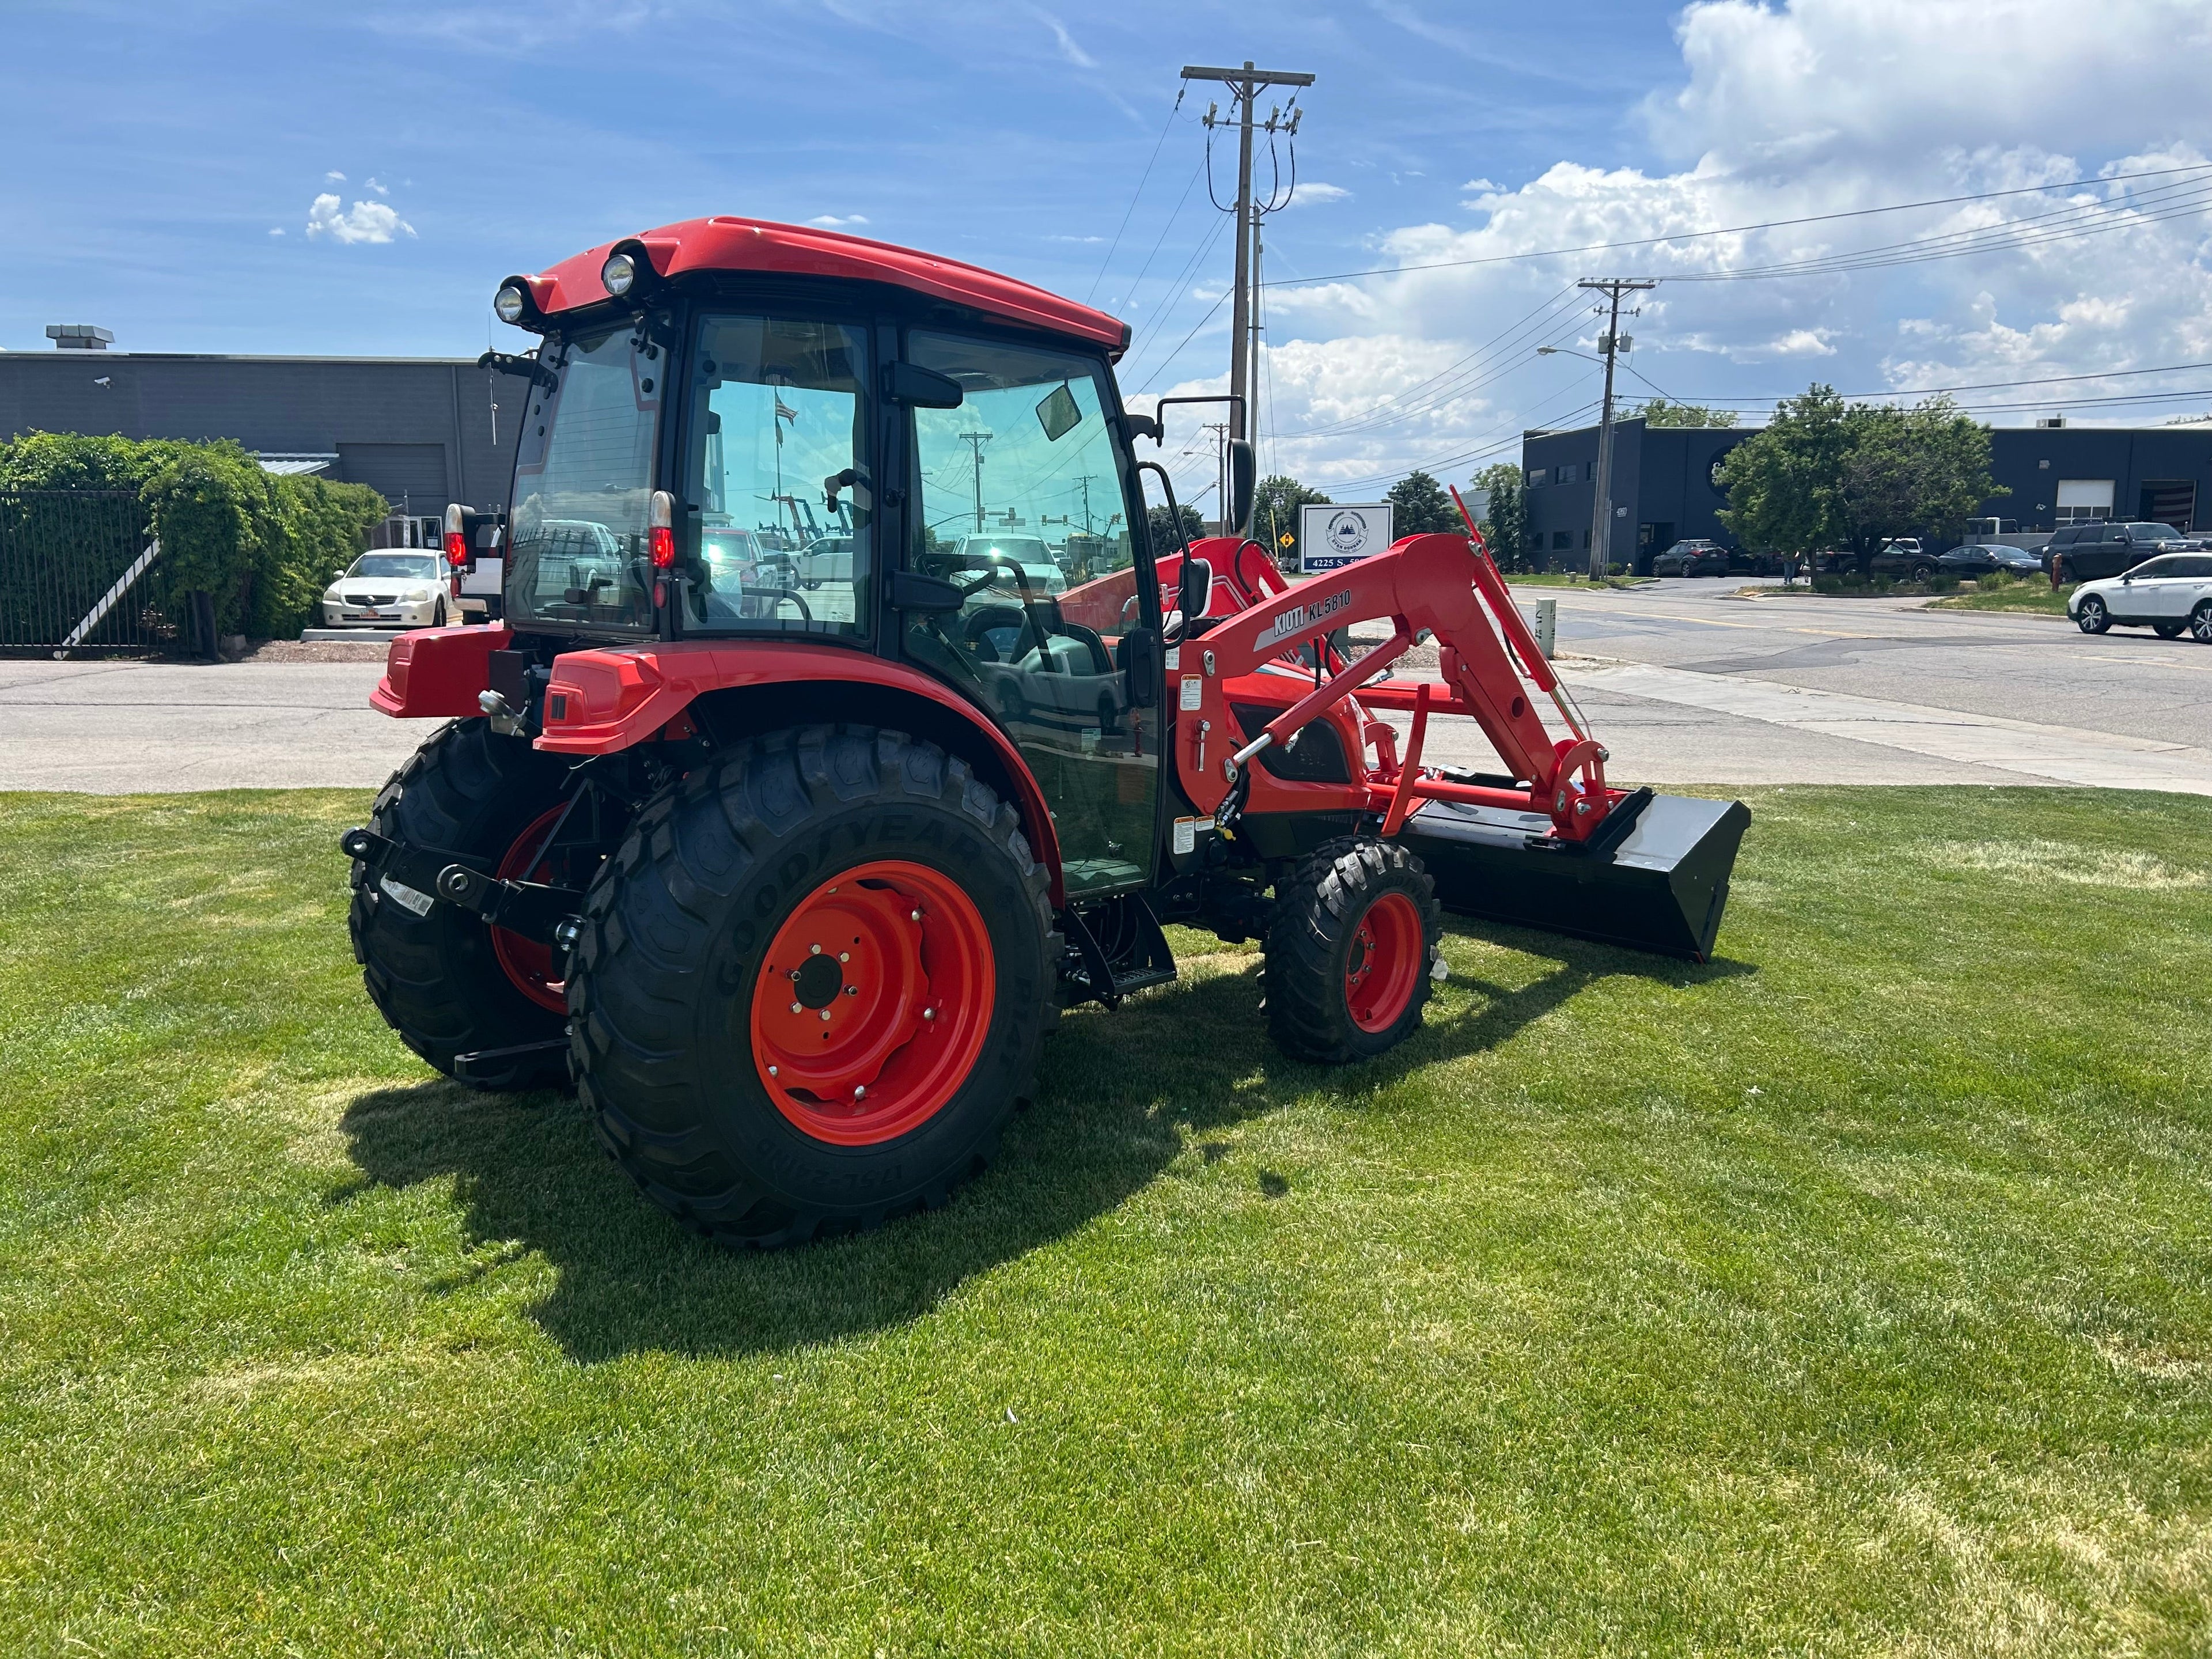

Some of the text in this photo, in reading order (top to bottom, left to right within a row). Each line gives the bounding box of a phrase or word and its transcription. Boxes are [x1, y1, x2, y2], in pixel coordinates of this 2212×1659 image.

[1312, 559, 1334, 567] 4225
[1274, 605, 1305, 637] KIOTI
[716, 813, 984, 997] GOODYEAR
